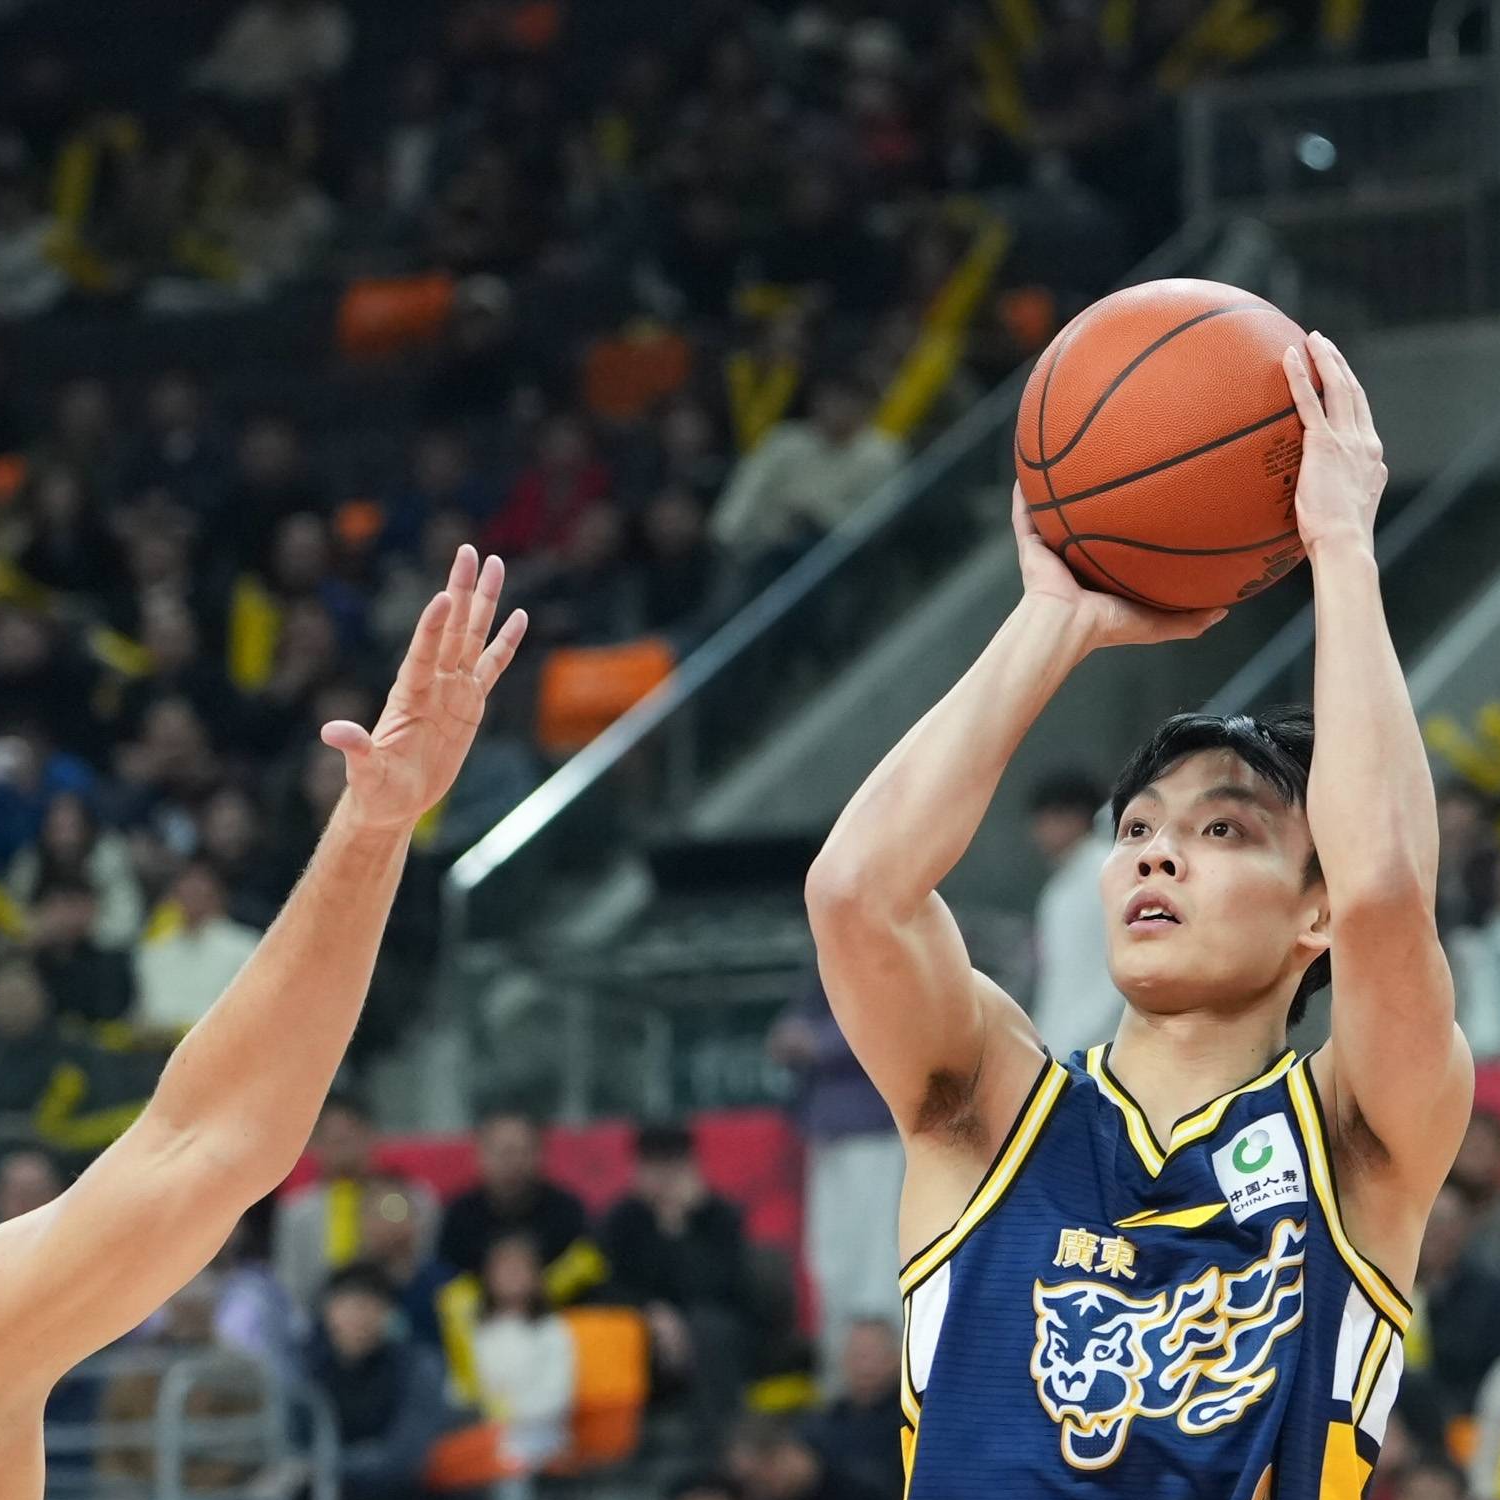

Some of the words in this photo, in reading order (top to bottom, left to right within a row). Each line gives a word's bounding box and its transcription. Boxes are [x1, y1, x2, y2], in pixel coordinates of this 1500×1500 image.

[1230, 1170, 1297, 1203] 中国人寿
[1233, 1193, 1271, 1213] CHINA
[1274, 1185, 1300, 1196] LIFE
[1052, 1227, 1138, 1280] 廣東
